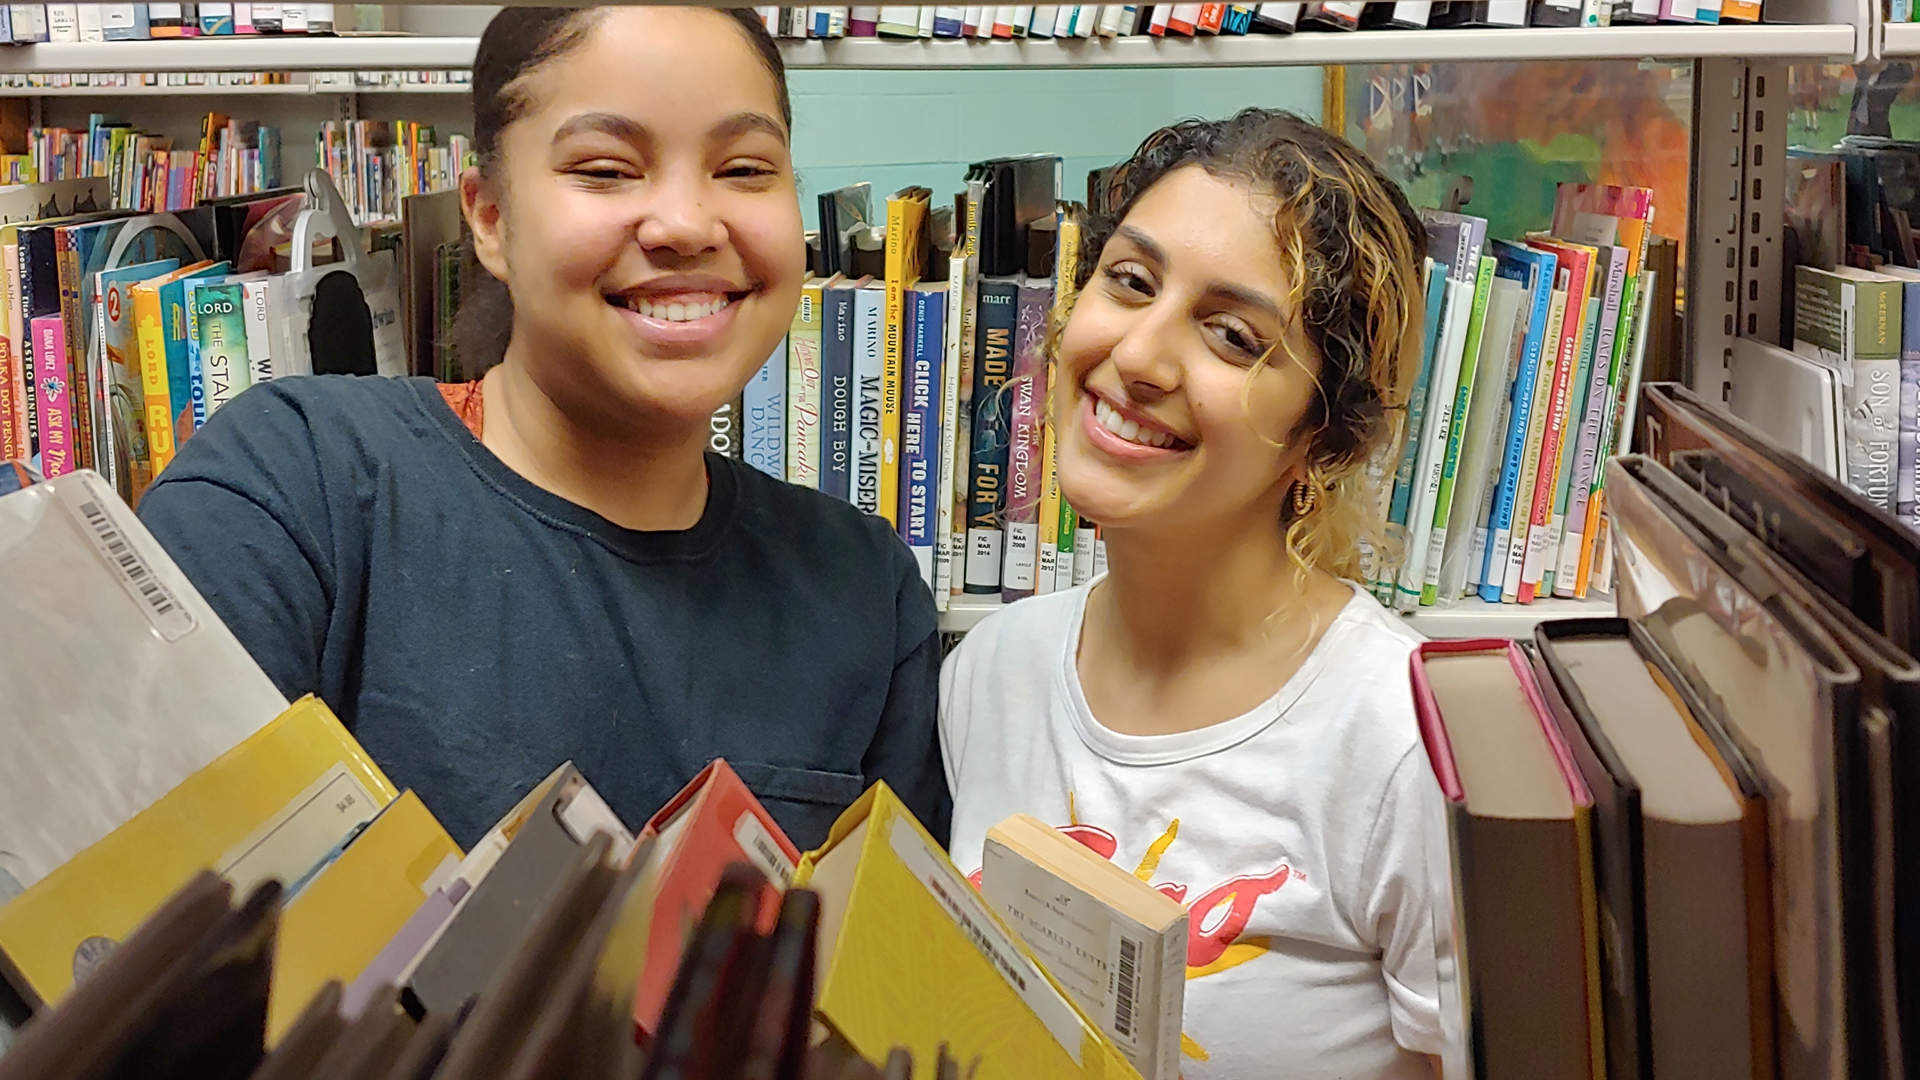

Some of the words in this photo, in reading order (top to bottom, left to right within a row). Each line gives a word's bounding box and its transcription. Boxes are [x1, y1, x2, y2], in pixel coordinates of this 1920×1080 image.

[891, 216, 900, 254] Marino
[969, 201, 978, 232] Family
[19, 246, 27, 278] Loomis
[967, 236, 977, 256] Pack
[1468, 244, 1480, 268] THE
[110, 292, 118, 316] 2
[891, 288, 898, 302] am
[982, 294, 1012, 304] marr
[1606, 260, 1624, 312] Marshall
[64, 301, 74, 348] ANDERSON
[198, 302, 232, 314] LORD
[255, 291, 266, 322] LORD
[838, 302, 848, 342] Marino
[890, 304, 898, 320] the
[964, 308, 972, 338] Markle
[1878, 290, 1888, 345] McKERNAN
[43, 328, 54, 350] DIANA
[212, 323, 222, 348] THE
[866, 306, 878, 358] MARINO
[916, 324, 924, 357] MARKELL
[1548, 305, 1562, 355] MARSHALL
[1580, 322, 1594, 370] MARSHALL
[1597, 327, 1612, 370] RATS
[24, 340, 34, 379] ASTRO
[146, 339, 158, 386] LORD
[984, 328, 1009, 386] MADE
[1, 389, 11, 416] DOT
[914, 360, 930, 408] CLICK
[1020, 376, 1032, 416] SWAN
[1540, 374, 1550, 408] GEORGE
[1594, 377, 1606, 400] ON
[1870, 370, 1891, 407] SON
[27, 386, 38, 438] BUNNIES
[47, 408, 62, 428] ASK
[834, 376, 848, 432] DOUGH
[860, 374, 881, 440] MAGIC
[48, 430, 64, 445] MY
[906, 413, 921, 454] HERE
[1535, 412, 1544, 434] AND
[1588, 406, 1600, 440] THE
[1874, 418, 1884, 432] OF
[794, 402, 818, 482] Pancake
[833, 440, 846, 472] BOY
[1528, 436, 1540, 477] MARTHA
[912, 460, 927, 480] TO
[1014, 424, 1030, 498] KINGDOM
[1576, 448, 1594, 507] RANGE
[1868, 442, 1890, 512] FORTUN
[858, 451, 878, 516] MISER
[976, 463, 1000, 504] FOR
[1524, 480, 1532, 504] TONS
[910, 485, 926, 538] START
[1521, 506, 1528, 517] OF
